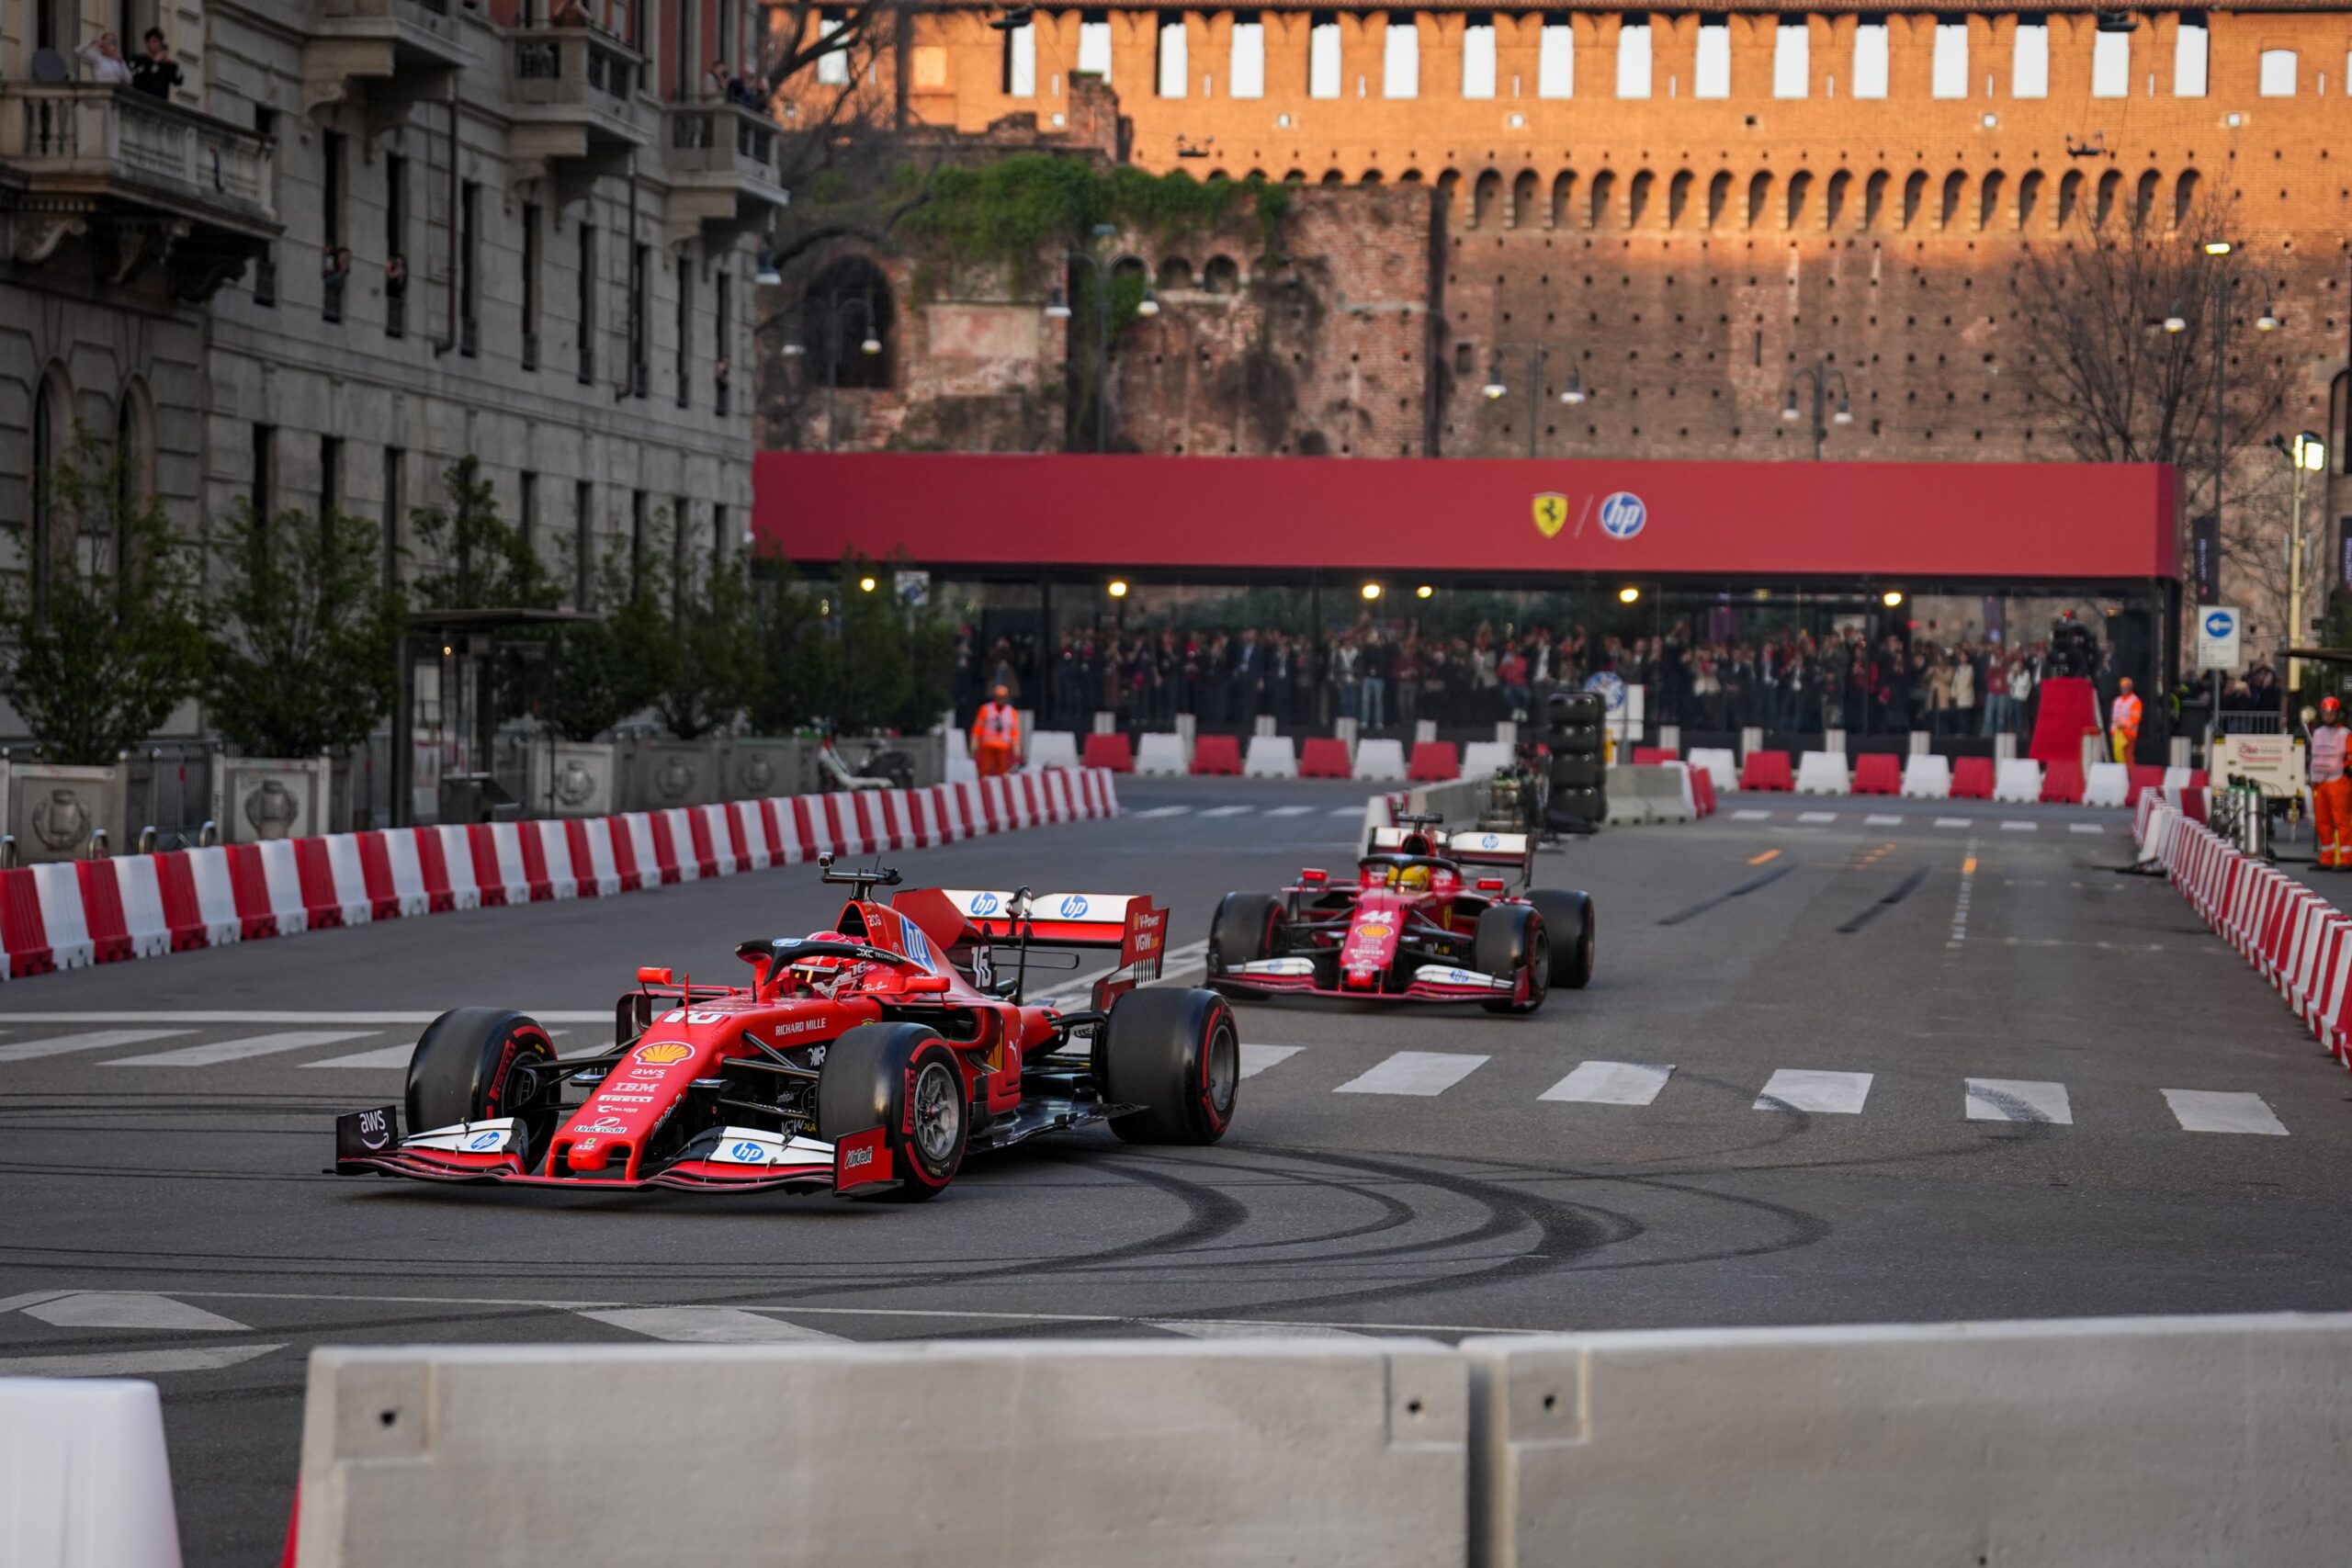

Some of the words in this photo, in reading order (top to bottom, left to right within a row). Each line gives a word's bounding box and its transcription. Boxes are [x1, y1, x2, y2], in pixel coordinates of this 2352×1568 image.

[1603, 492, 1644, 536] hp
[971, 892, 998, 915] hp
[1061, 895, 1088, 918] hp
[1360, 909, 1394, 924] 44
[900, 913, 937, 974] hp
[849, 961, 867, 976] 16
[971, 945, 992, 988] 16
[775, 1021, 805, 1036] RICHARD
[806, 1017, 827, 1031] MILLE
[631, 1068, 667, 1077] aws
[612, 1082, 661, 1093] IBM
[359, 1110, 386, 1134] aws
[574, 1124, 627, 1134] UniCredit
[732, 1142, 764, 1162] hp
